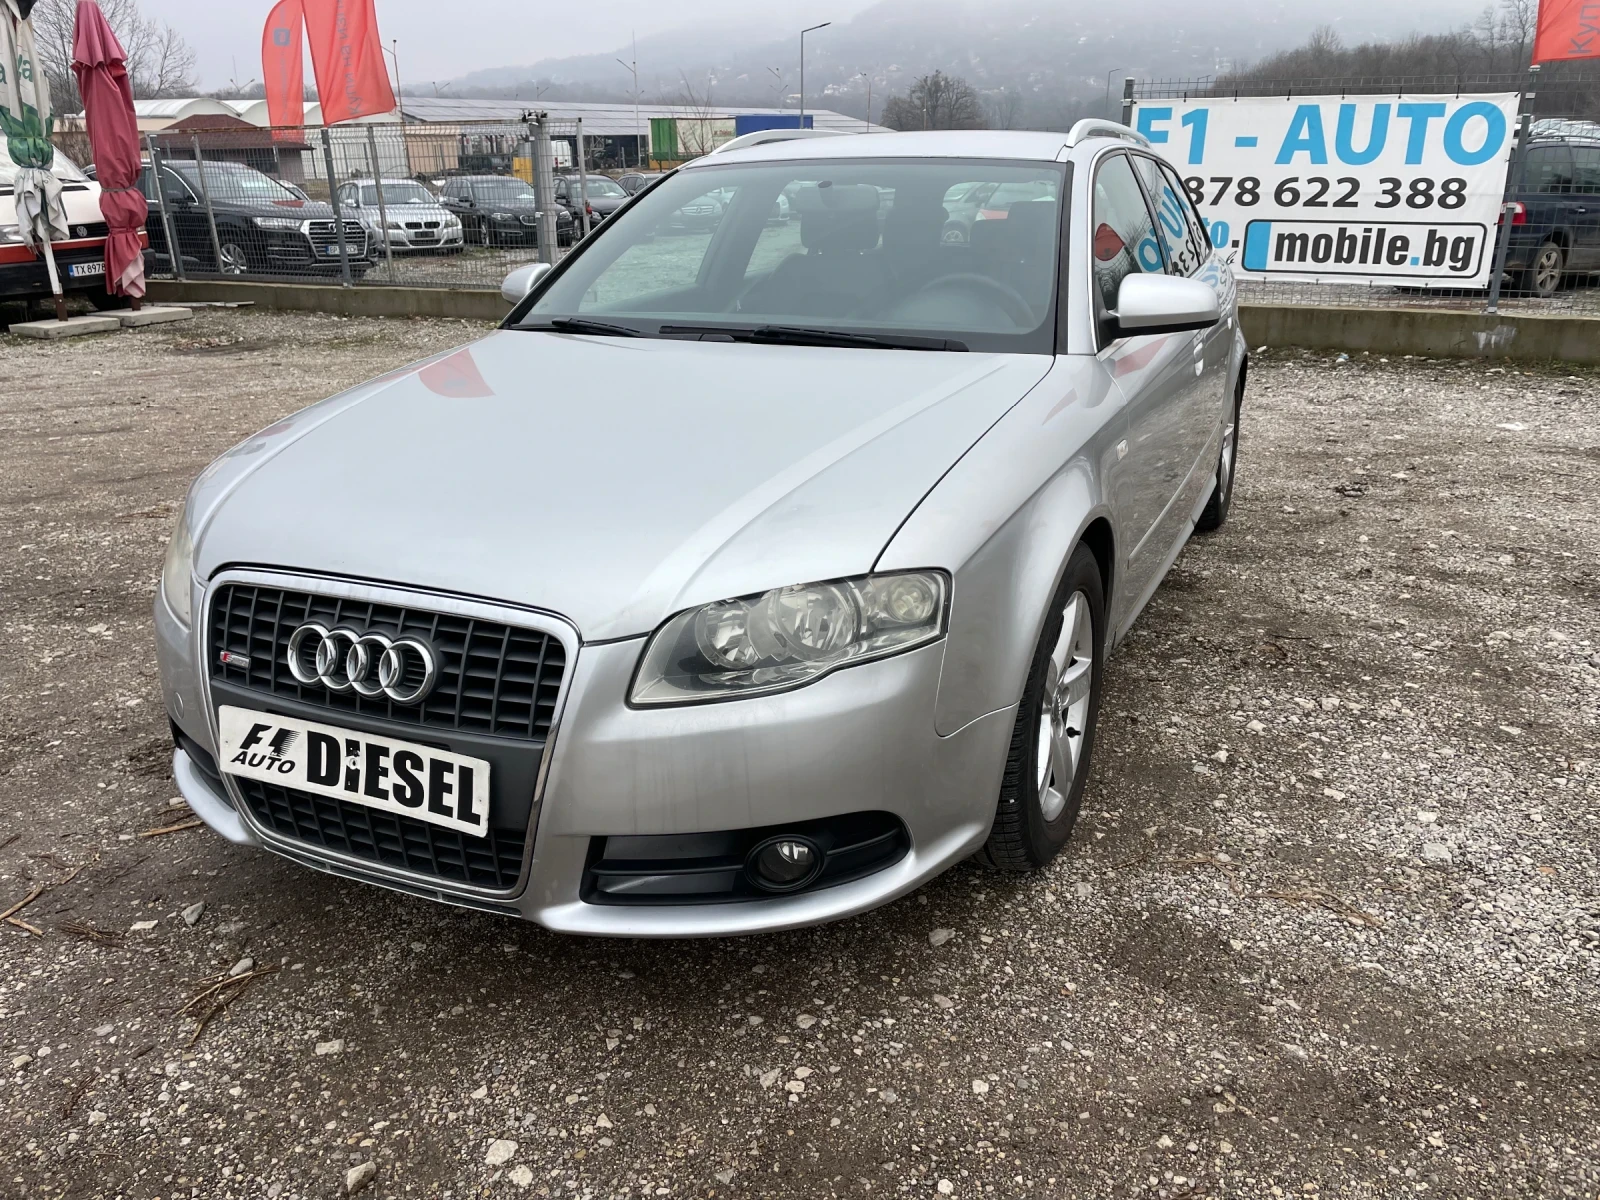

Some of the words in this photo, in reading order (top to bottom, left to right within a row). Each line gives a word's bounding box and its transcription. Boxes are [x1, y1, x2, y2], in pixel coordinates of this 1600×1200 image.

[1136, 108, 1209, 165] F1
[1234, 136, 1258, 148] -
[1275, 102, 1507, 166] AUTO
[1273, 177, 1359, 208] 622
[1374, 177, 1467, 209] 388
[1274, 226, 1475, 272] mobile.bg
[239, 722, 301, 757] F1
[230, 750, 297, 774] AUTO
